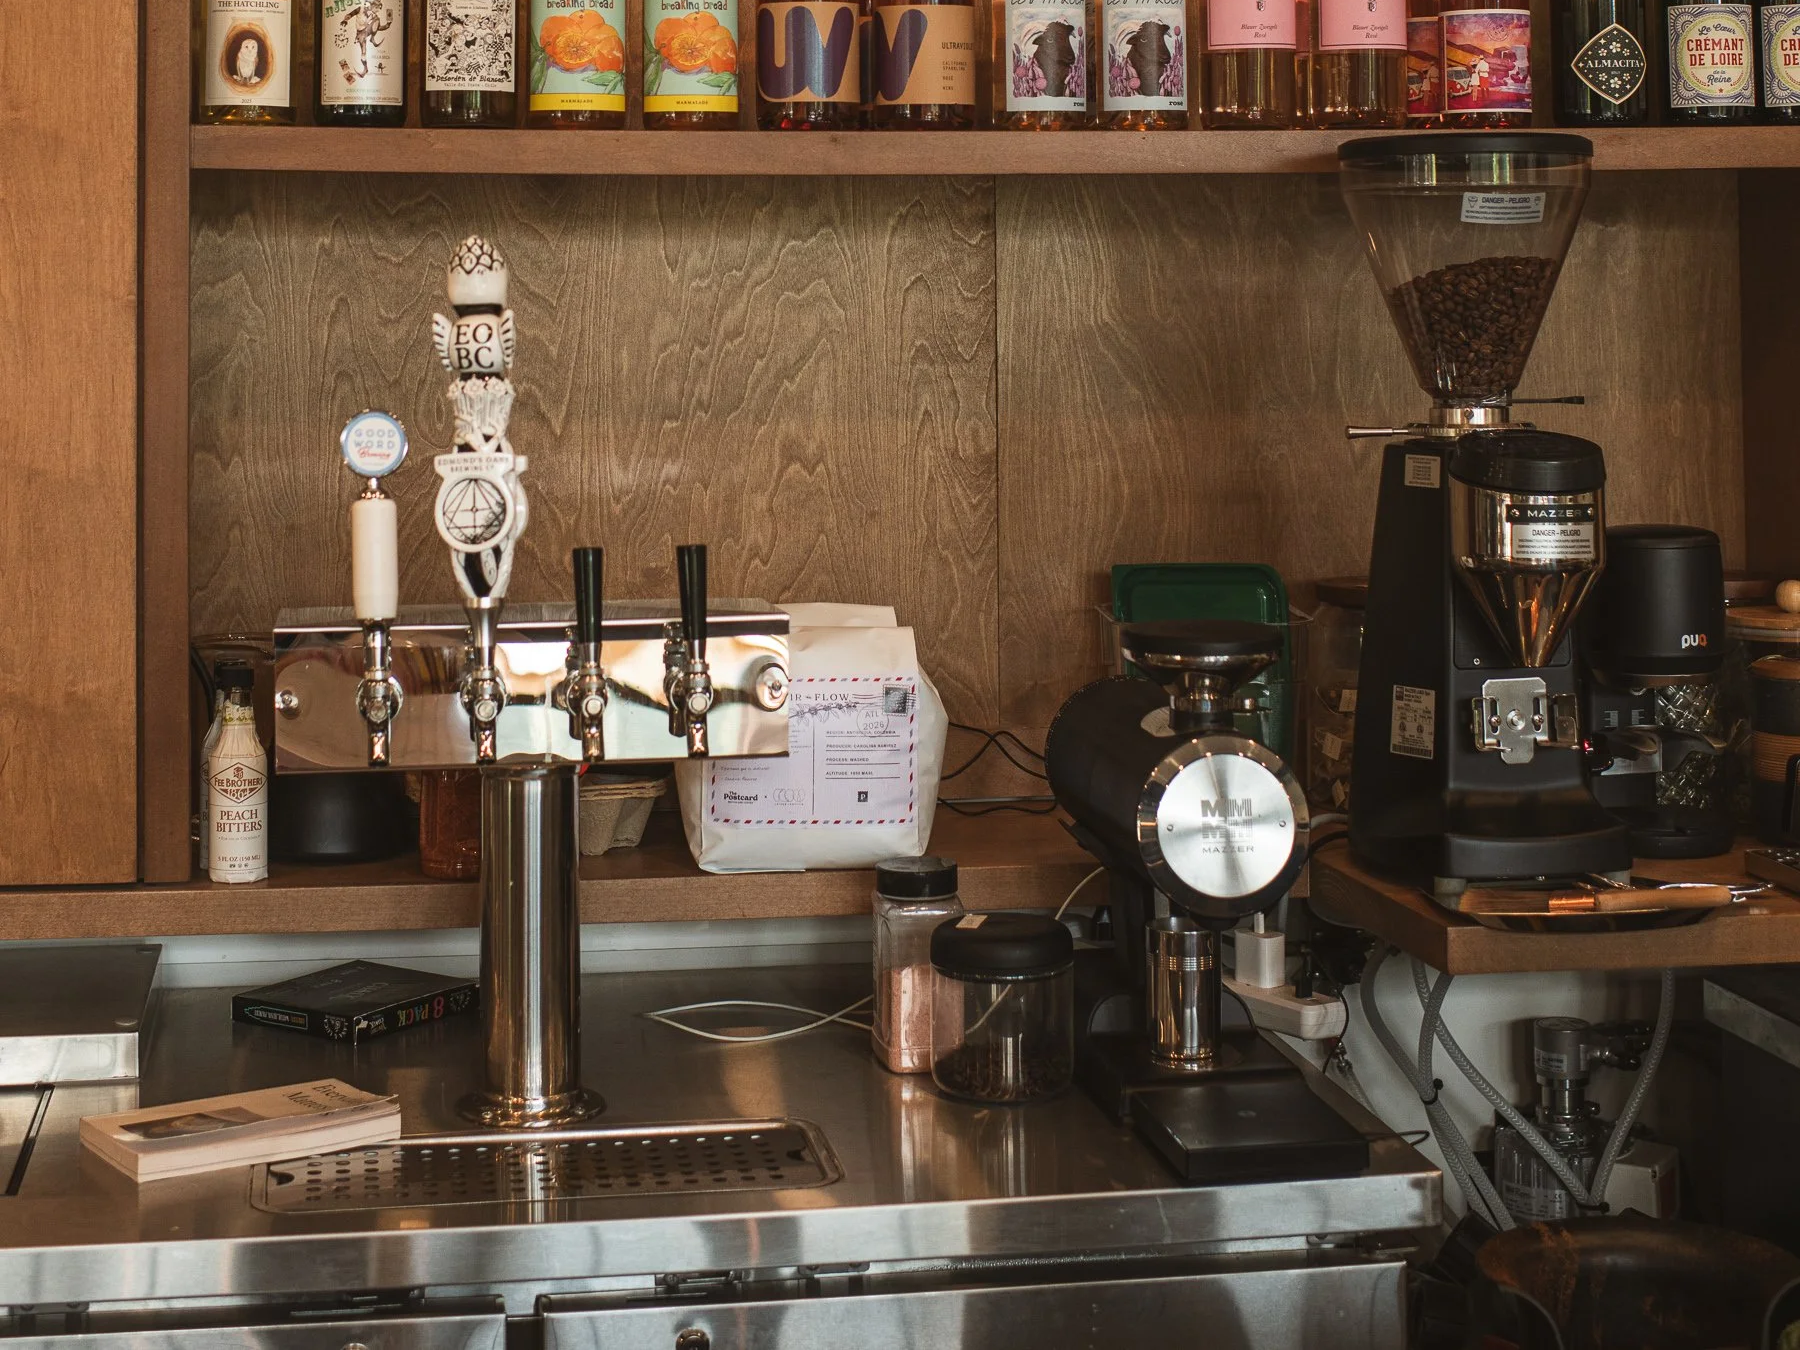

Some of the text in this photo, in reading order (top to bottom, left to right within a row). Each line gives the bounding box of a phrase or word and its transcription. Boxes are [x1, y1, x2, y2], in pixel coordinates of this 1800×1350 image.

[218, 0, 280, 9] THE HATCHLING
[1686, 36, 1744, 52] CRÉMANT
[1586, 59, 1640, 68] ALMACITA
[1689, 52, 1744, 67] DE LOIRE
[455, 322, 493, 346] EO
[455, 345, 495, 370] BC
[1527, 509, 1581, 518] MAZZER
[814, 693, 850, 702] FLOW
[214, 777, 225, 787] FEE
[723, 793, 758, 801] Postcard
[220, 808, 258, 821] PEACH
[216, 819, 263, 833] BITTERS
